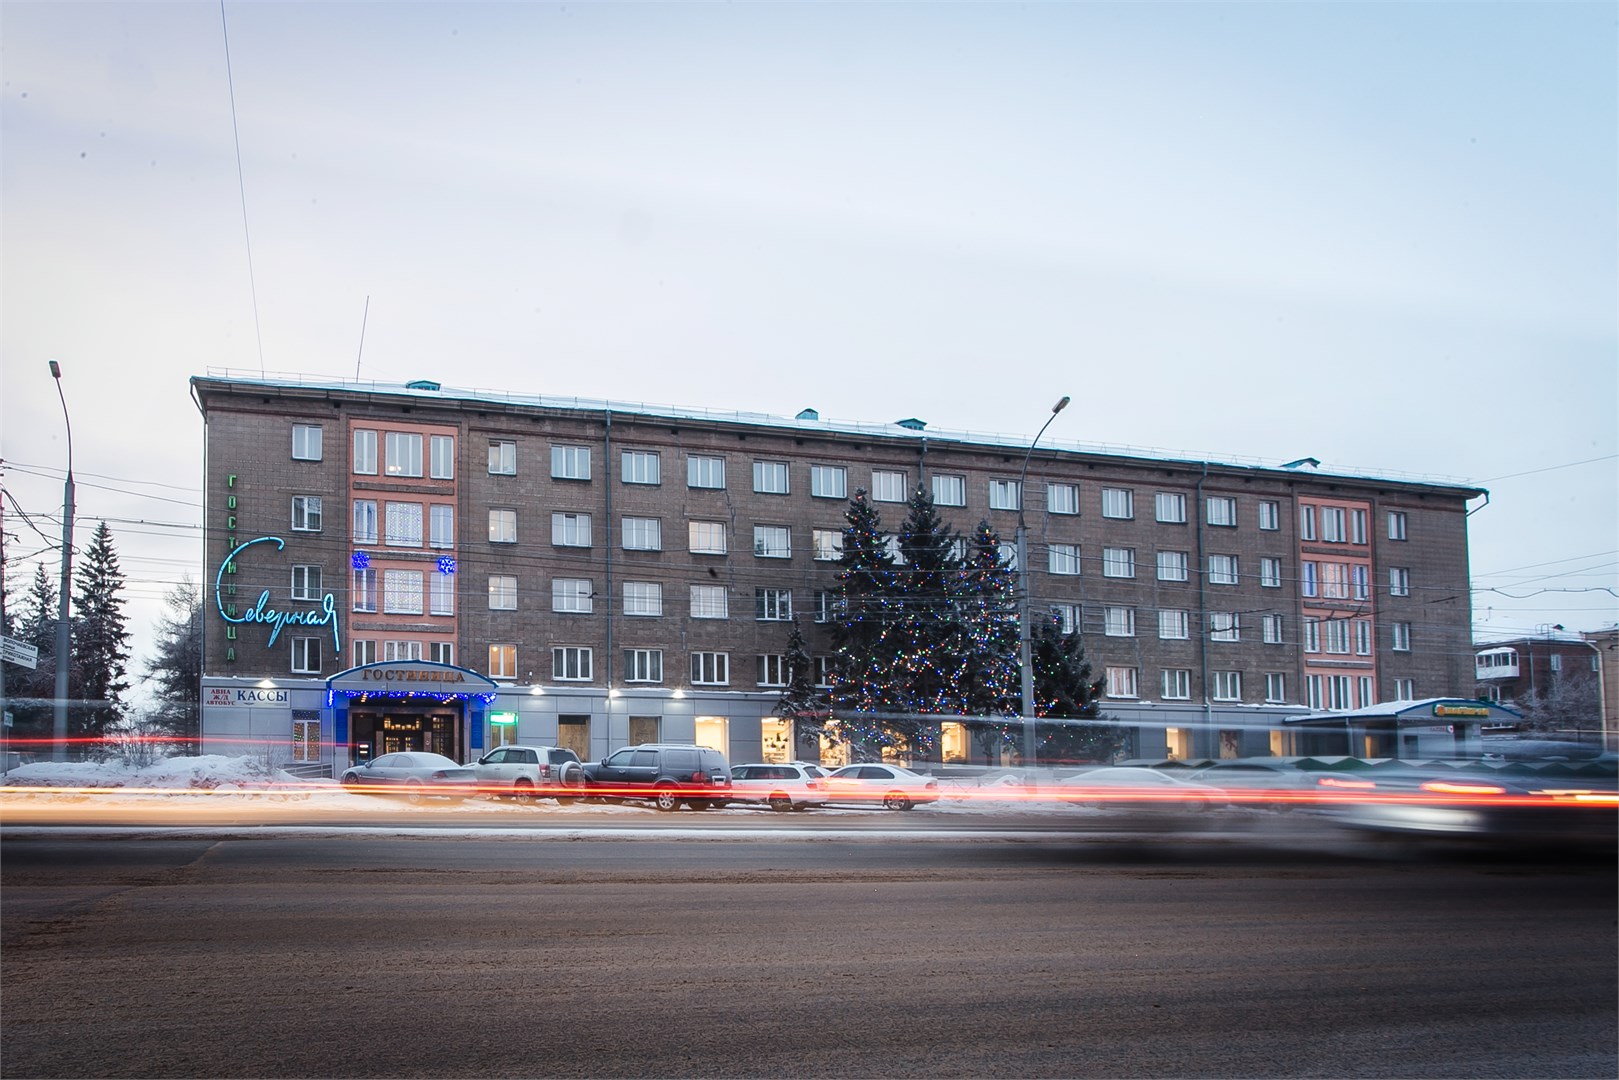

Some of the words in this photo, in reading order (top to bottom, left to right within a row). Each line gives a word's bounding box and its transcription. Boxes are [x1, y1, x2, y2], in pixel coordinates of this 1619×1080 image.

[216, 536, 340, 652] Северная
[227, 474, 237, 661] ГОСТИНИЦА
[237, 690, 287, 702] КАССЫ
[362, 669, 465, 684] ГОСТИНИЦА
